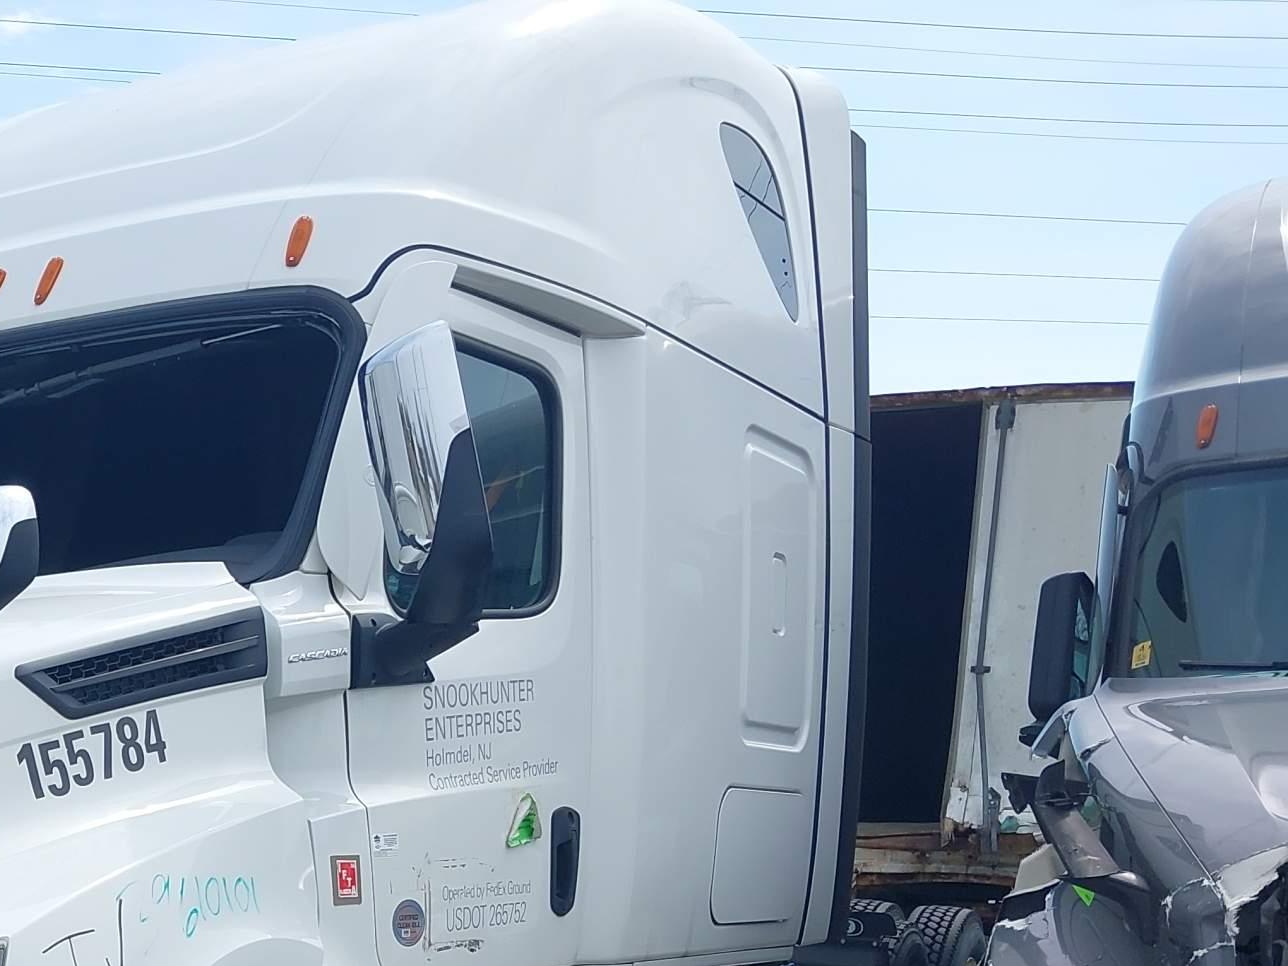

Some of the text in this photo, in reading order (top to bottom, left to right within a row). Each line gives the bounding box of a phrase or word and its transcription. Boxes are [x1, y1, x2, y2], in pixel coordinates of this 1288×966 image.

[287, 647, 349, 664] CASCADIA
[423, 679, 534, 710] SNOOKHUNTER
[425, 709, 522, 742] ENTERPRISES
[16, 709, 167, 800] 155784
[426, 742, 492, 768] Holmdel, NJ
[428, 757, 559, 791] Contracted Service Provider
[442, 880, 531, 902] Operated by FedEx Ground
[446, 901, 527, 932] USDOT 265752
